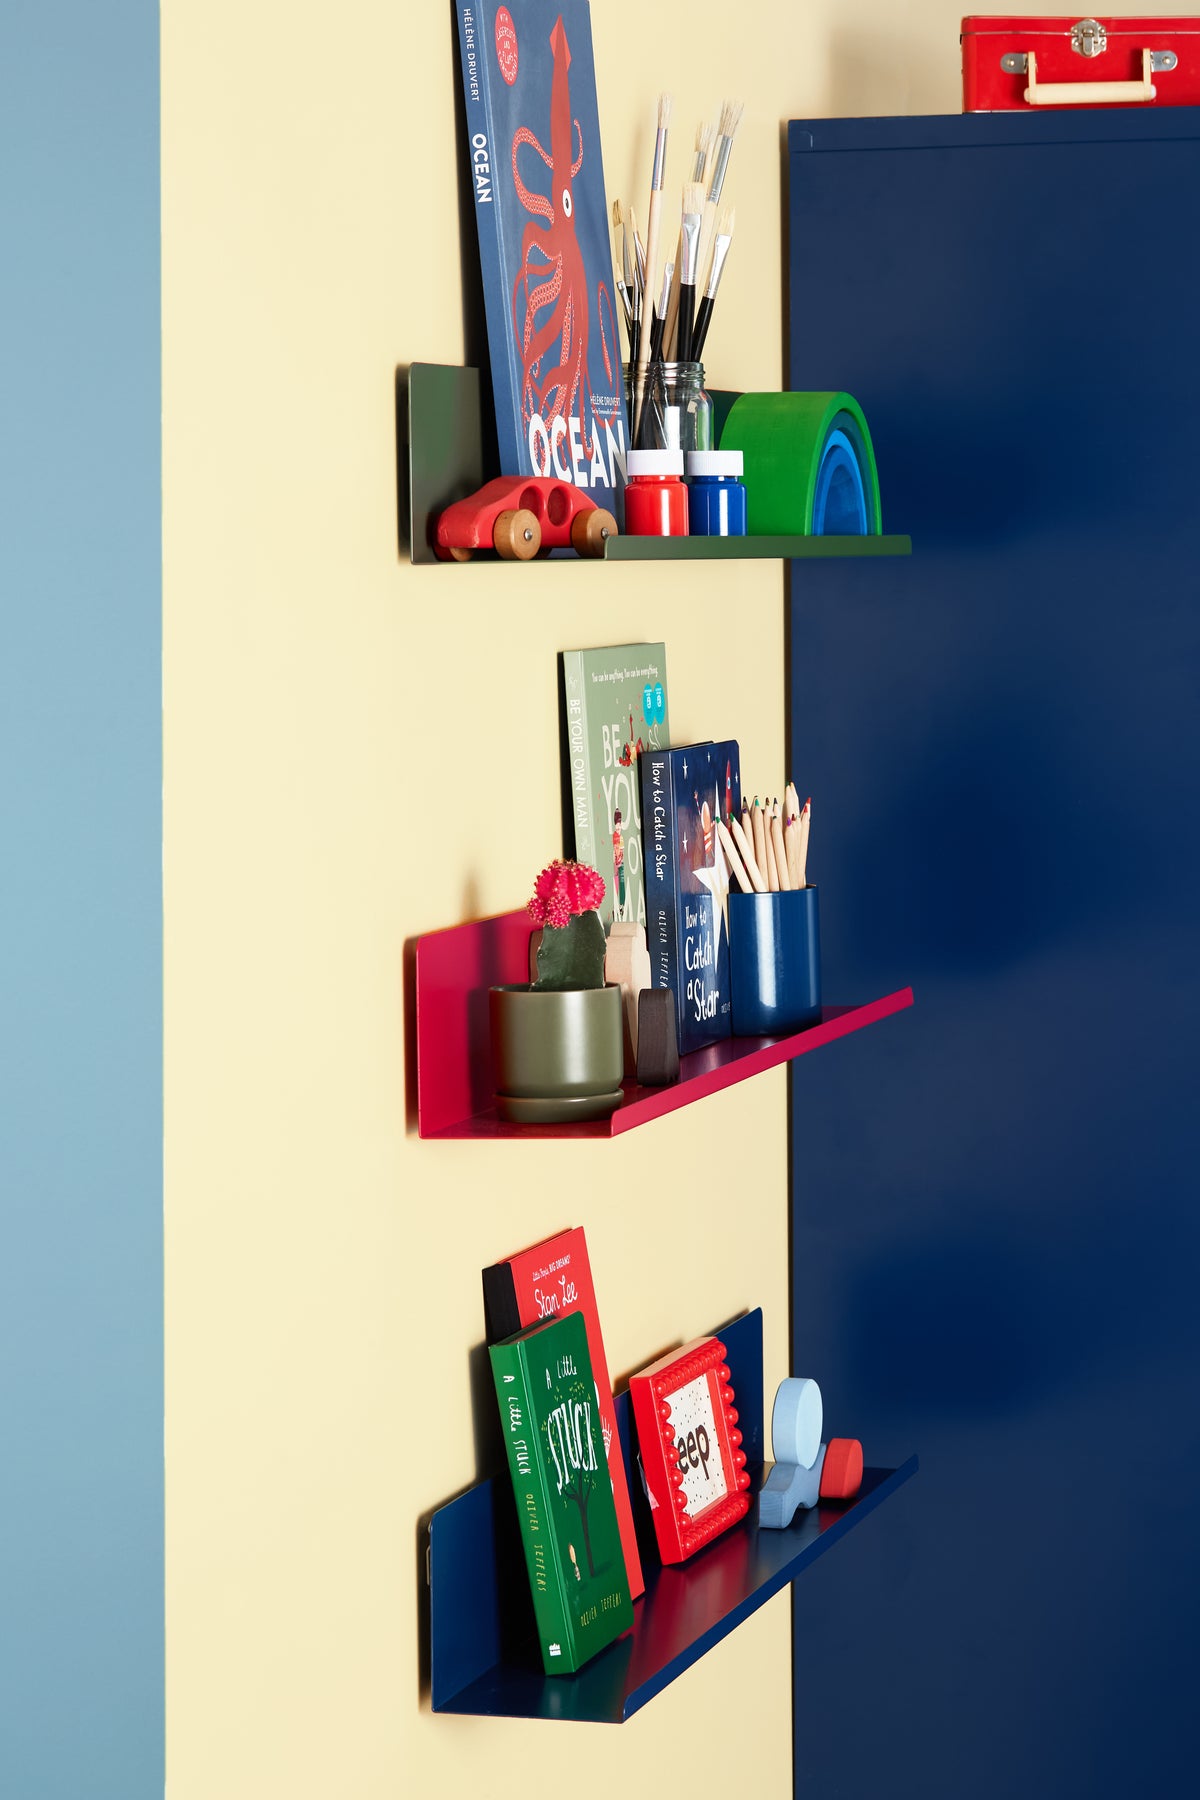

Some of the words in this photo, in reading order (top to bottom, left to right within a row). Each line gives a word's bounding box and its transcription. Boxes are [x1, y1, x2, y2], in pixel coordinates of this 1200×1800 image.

[463, 8, 475, 49] HÉLÈNE
[467, 53, 480, 101] DRUVERT
[472, 133, 493, 203] OCEAN
[529, 413, 629, 488] OCEAN
[570, 699, 581, 714] BE
[571, 718, 583, 753] YOUR
[602, 724, 620, 768] BE
[573, 758, 586, 791] OWN
[652, 762, 665, 786] How
[576, 797, 589, 828] MAN
[652, 789, 664, 804] to
[653, 806, 666, 840] Catch
[655, 843, 662, 851] a
[655, 854, 667, 881] Star
[658, 910, 666, 943] OLIVER
[685, 906, 697, 929] How
[699, 905, 707, 926] to
[685, 930, 713, 971] Catch
[660, 952, 669, 987] JEFFER
[687, 979, 693, 1001] a
[694, 978, 720, 1022] Star
[548, 1262, 556, 1273] BIG
[534, 1288, 560, 1319] Stan
[557, 1274, 578, 1307] Lee
[545, 1367, 552, 1390] A
[503, 1375, 516, 1383] A
[513, 1439, 531, 1475] STUCK
[547, 1399, 599, 1496] STUCK
[525, 1493, 539, 1532] OLIVER
[534, 1544, 547, 1592] JEFFERS
